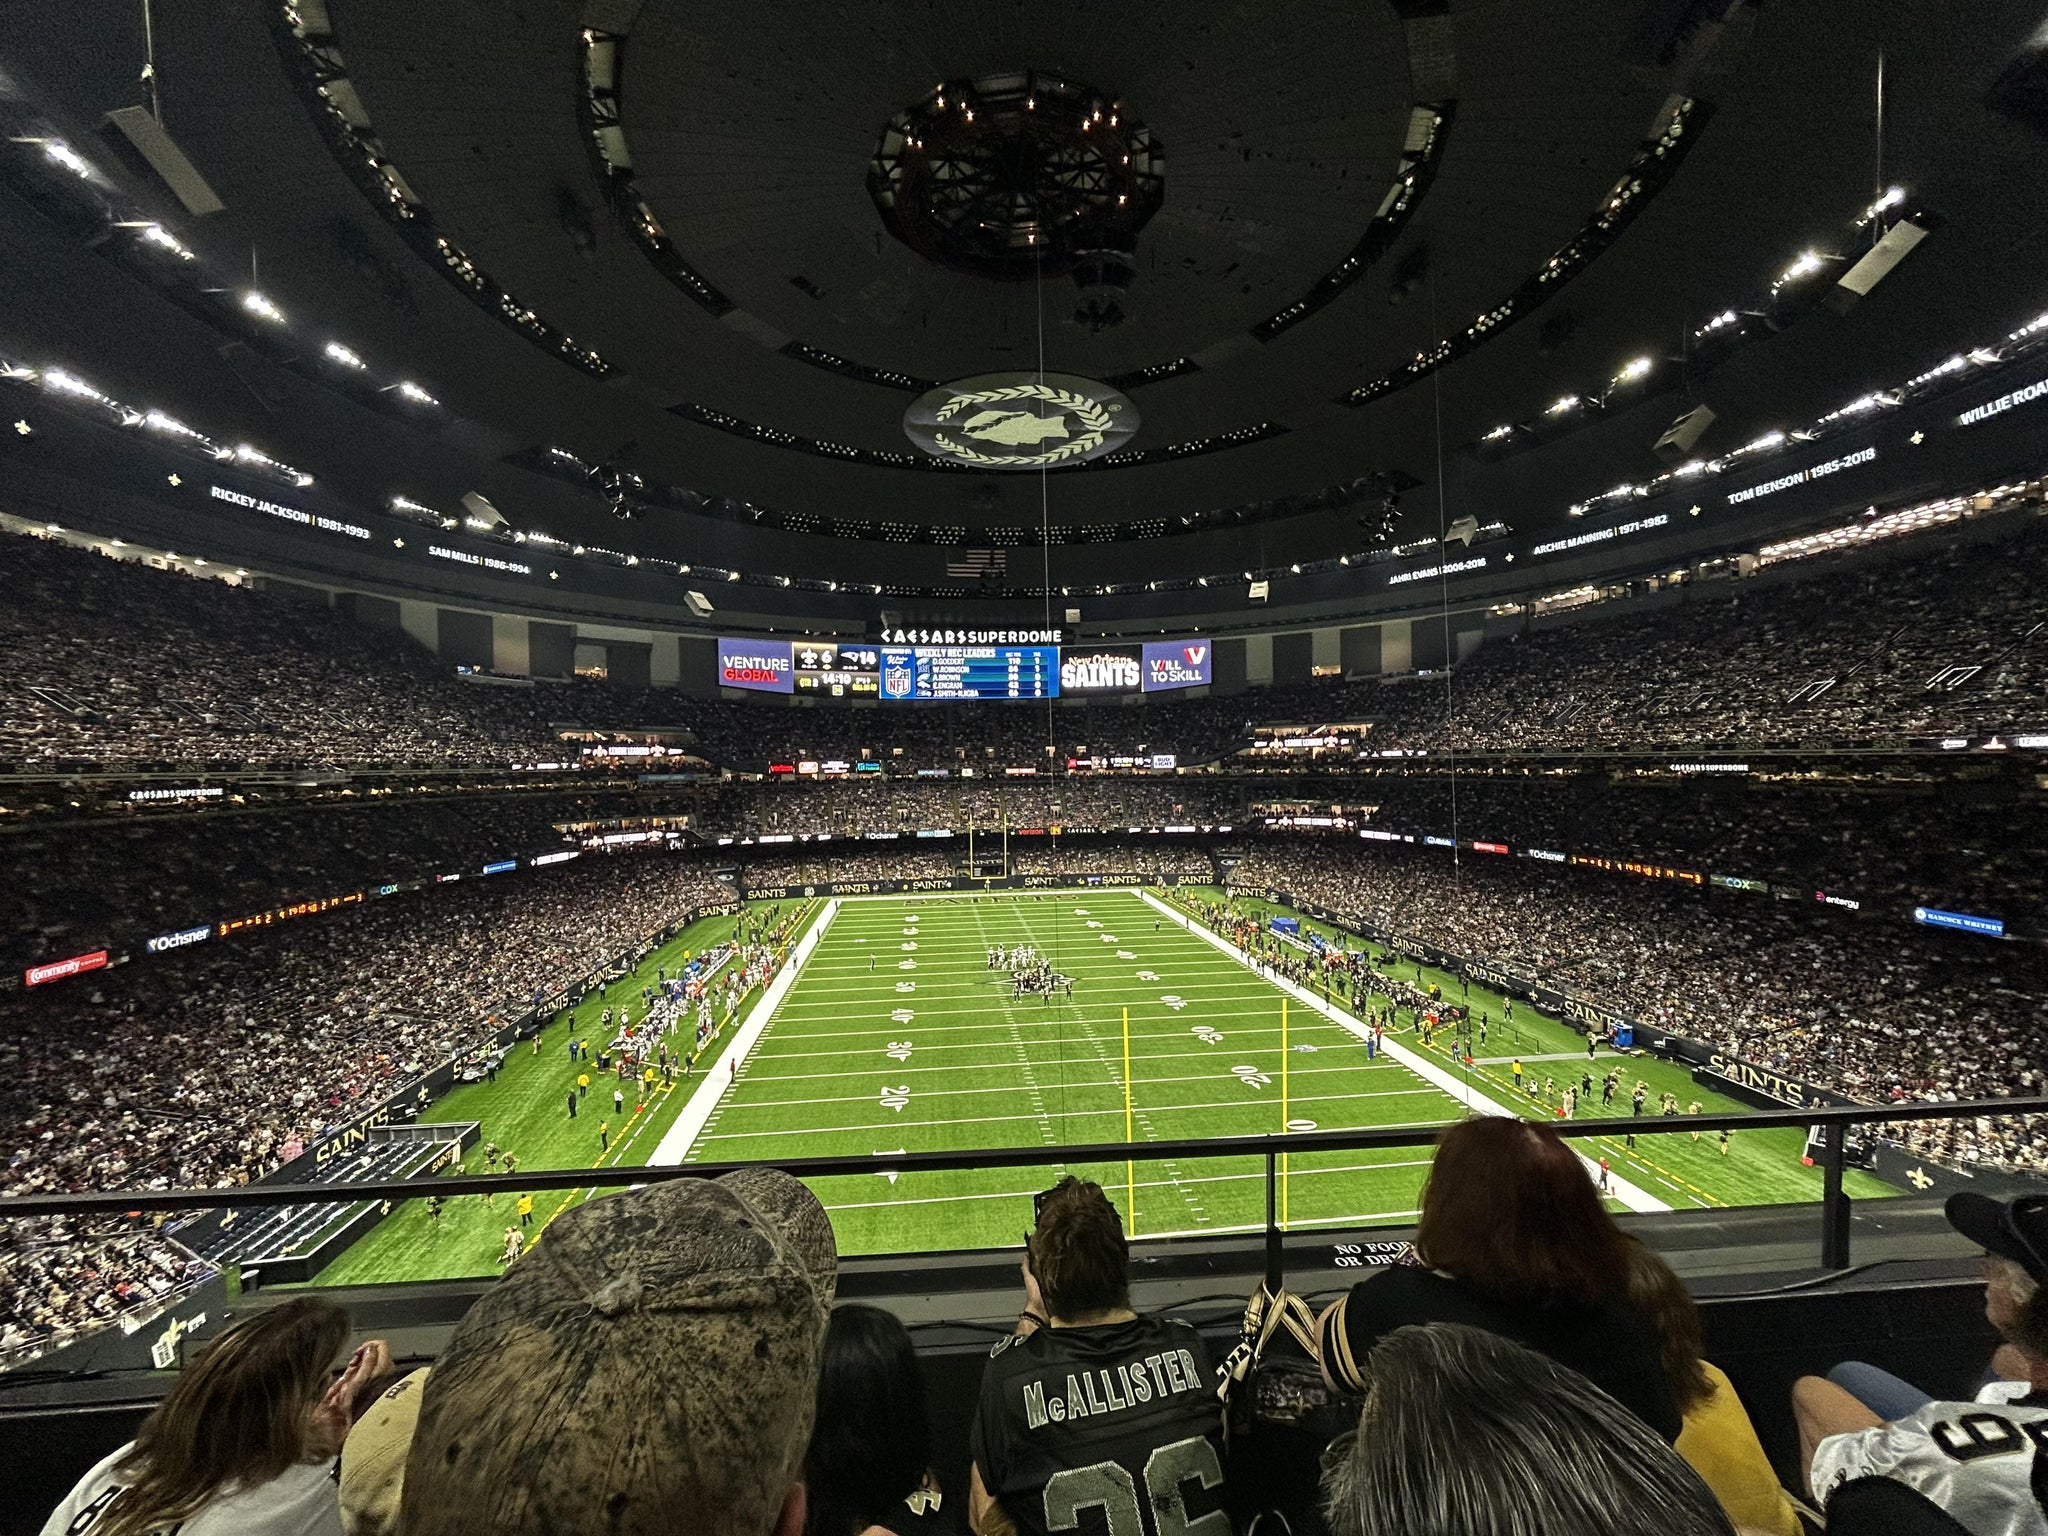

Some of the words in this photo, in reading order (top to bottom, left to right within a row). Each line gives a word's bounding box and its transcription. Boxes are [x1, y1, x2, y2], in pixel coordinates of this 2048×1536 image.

[1960, 395, 2012, 425] WILLIE
[1728, 489, 1754, 505] TOM
[1755, 472, 1804, 496] BENSON
[1810, 447, 1876, 478] 1985-2018
[211, 486, 256, 508] RICKEY
[257, 501, 310, 524] JACKSON
[317, 517, 370, 539] 1981-1993
[1534, 540, 1567, 555] ARCHIE
[1567, 529, 1613, 547] MANNING
[1618, 515, 1668, 535] 1971-1982
[428, 546, 451, 558] SAM
[451, 551, 479, 564] MILLS
[1389, 572, 1411, 584] JAHRI
[1412, 567, 1438, 580] EVANS
[881, 629, 967, 644] CAESARS
[968, 630, 1062, 643] SUPERDOME
[821, 650, 832, 664] 6
[860, 651, 876, 665] 14
[915, 648, 947, 657] WEEKLY
[963, 649, 996, 658] LEADERS
[724, 656, 789, 671] VENTURE
[1151, 660, 1181, 672] WILL
[724, 669, 779, 682] GLOBAL
[1062, 662, 1139, 687] SAINTS
[1151, 672, 1168, 683] TO
[1169, 670, 1202, 682] SKILL
[889, 680, 907, 692] NFL
[1705, 764, 1748, 772] SUPERDOME
[130, 790, 175, 799] CAESARS
[175, 788, 223, 798] SUPERDOME
[1533, 849, 1565, 862] Ochsner
[1102, 876, 1136, 884] SAINTS
[1178, 876, 1213, 884] SAINTS
[1726, 877, 1750, 890] COX
[381, 884, 398, 895] COX
[748, 889, 786, 900] SAINTS
[832, 884, 870, 894] SAINTS
[1826, 896, 1860, 910] entergy
[1337, 915, 1361, 931] SAINTS
[1928, 913, 1962, 925] HANCOCK
[1964, 920, 2003, 932] WHITNEY
[157, 928, 210, 950] Ochsner
[1392, 936, 1424, 957] SAINTS
[31, 958, 80, 983] Community
[1465, 963, 1507, 987] SAINTS
[1191, 1026, 1223, 1041] 30
[886, 1041, 913, 1058] 30
[1231, 1065, 1272, 1085] 20
[1710, 1055, 1803, 1104] SAINTS
[880, 1085, 911, 1107] 20
[316, 1106, 389, 1162] SAINTS
[1334, 1245, 1361, 1255] NO
[1335, 1256, 1362, 1267] OR
[1023, 1349, 1202, 1430] McALLISTER
